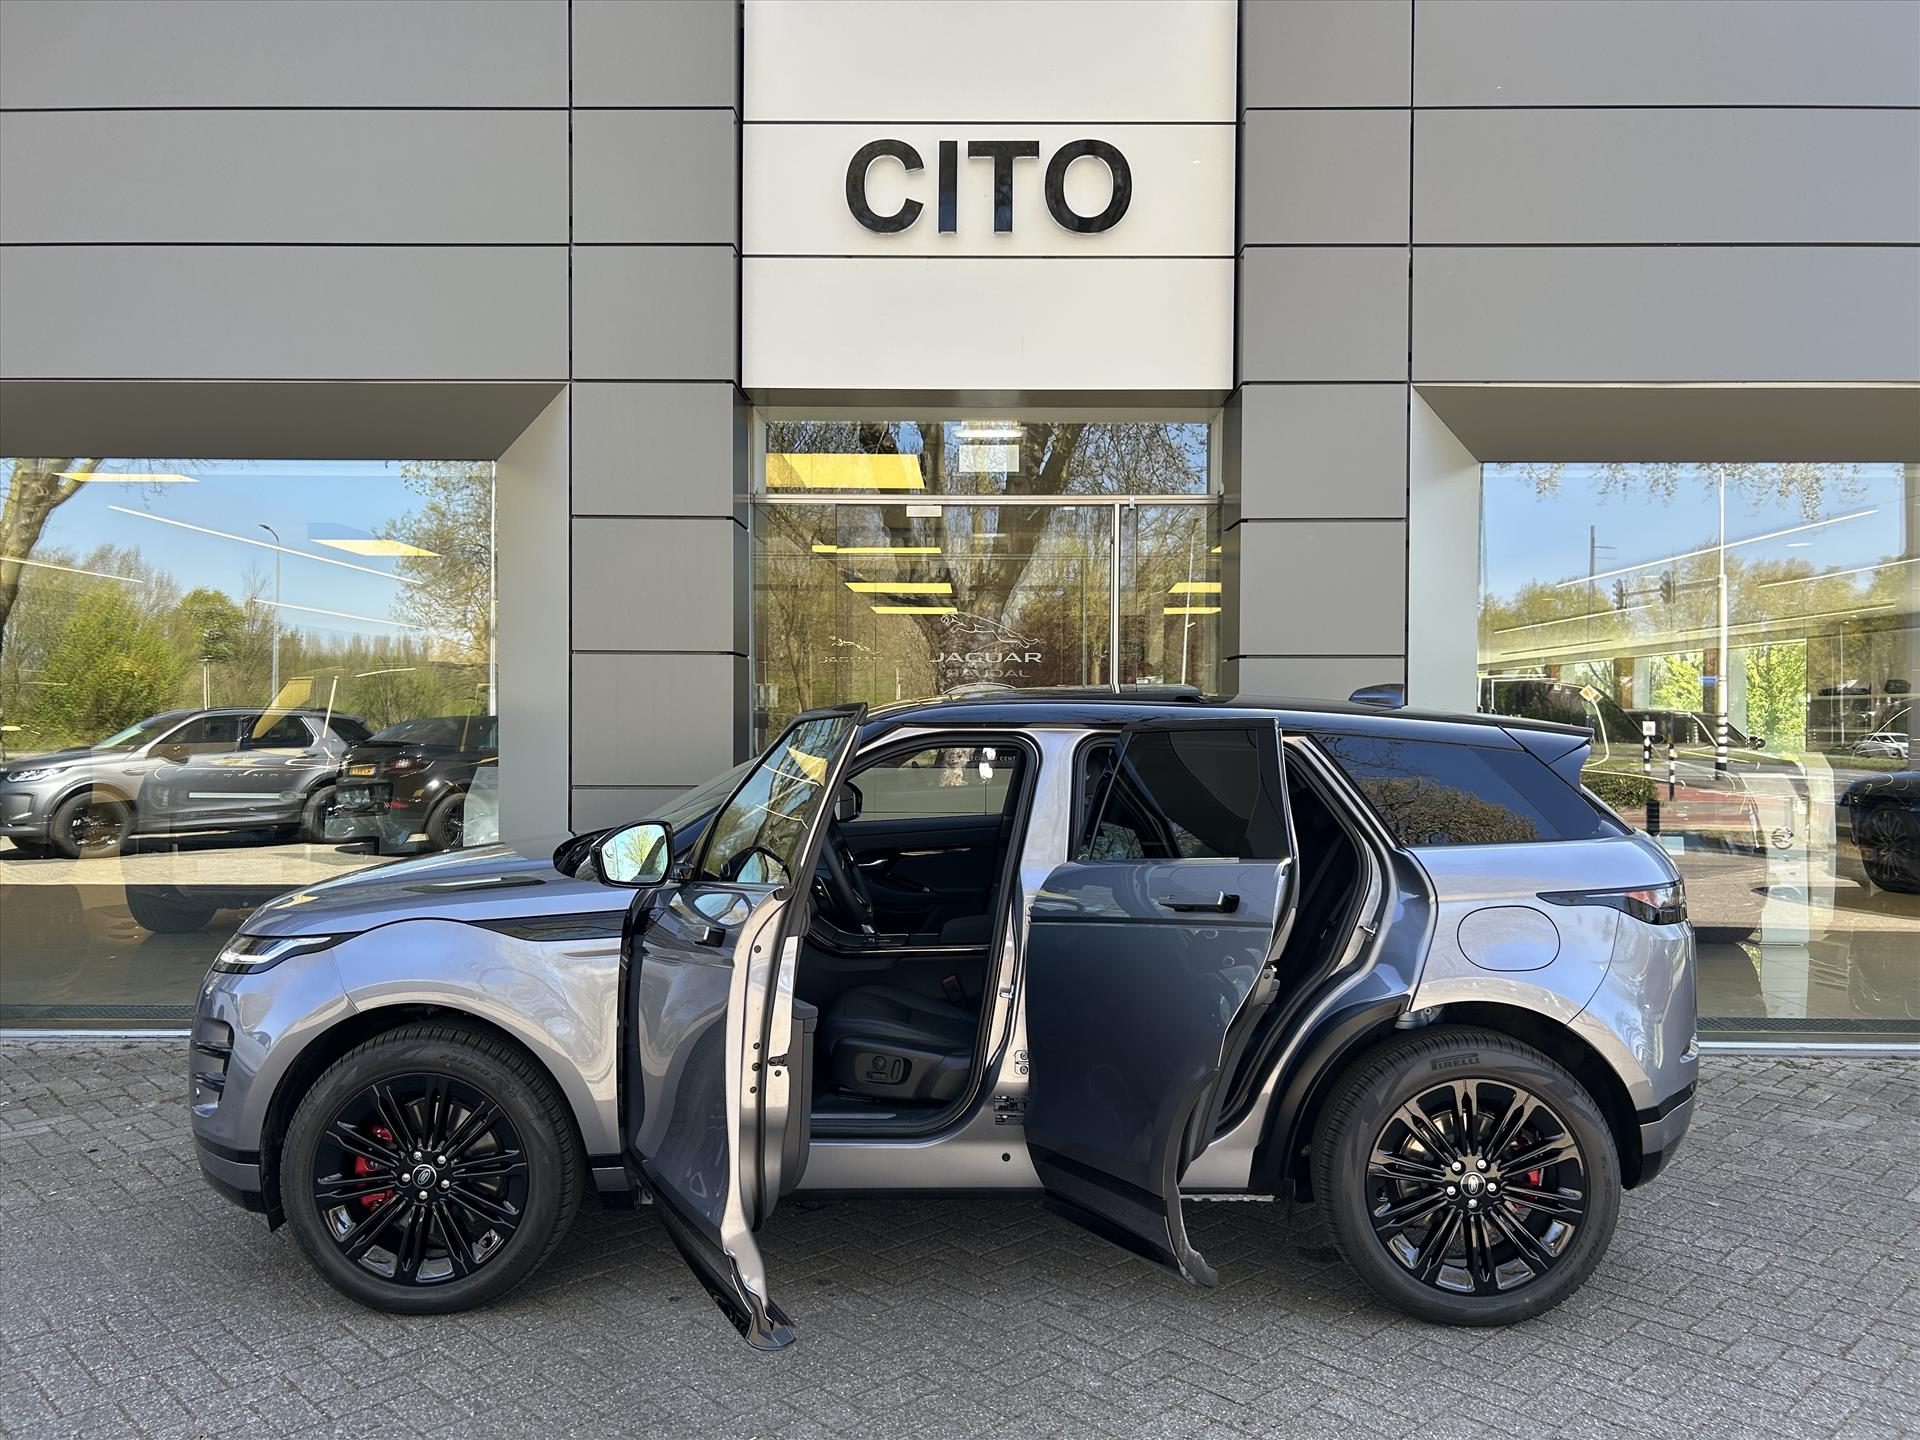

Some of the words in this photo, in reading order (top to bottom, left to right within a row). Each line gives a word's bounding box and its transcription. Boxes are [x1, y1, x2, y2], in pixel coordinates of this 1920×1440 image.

[845, 138, 1133, 234] CITO
[929, 652, 1042, 663] JAGUAR
[1430, 1053, 1480, 1071] PIRELLI
